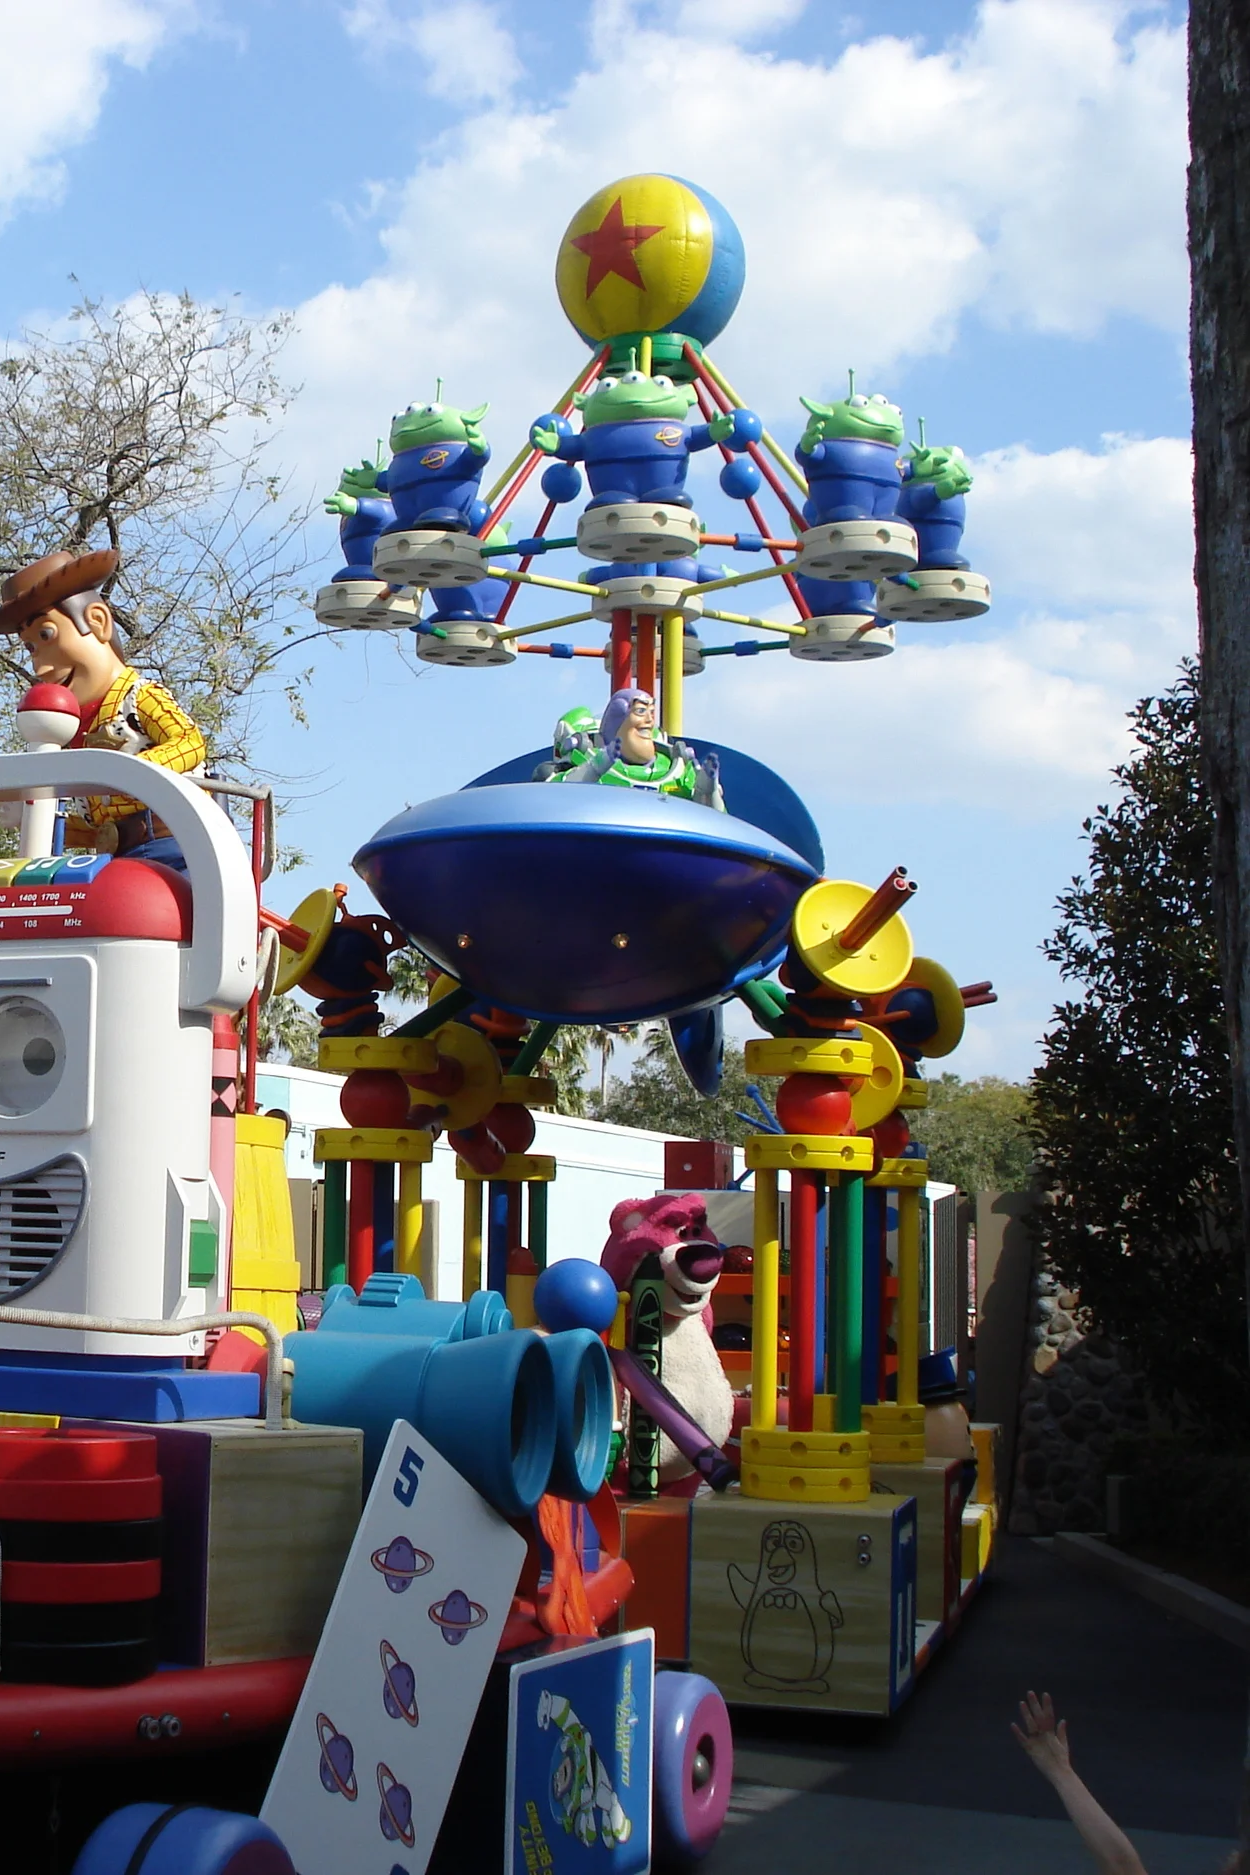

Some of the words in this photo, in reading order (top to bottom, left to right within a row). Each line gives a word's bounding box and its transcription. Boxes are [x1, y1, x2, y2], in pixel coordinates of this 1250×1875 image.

[19, 893, 38, 902] 1400
[41, 893, 60, 901] 1700
[70, 892, 86, 900] kHz
[63, 918, 82, 927] MHz
[393, 1445, 425, 1508] 5
